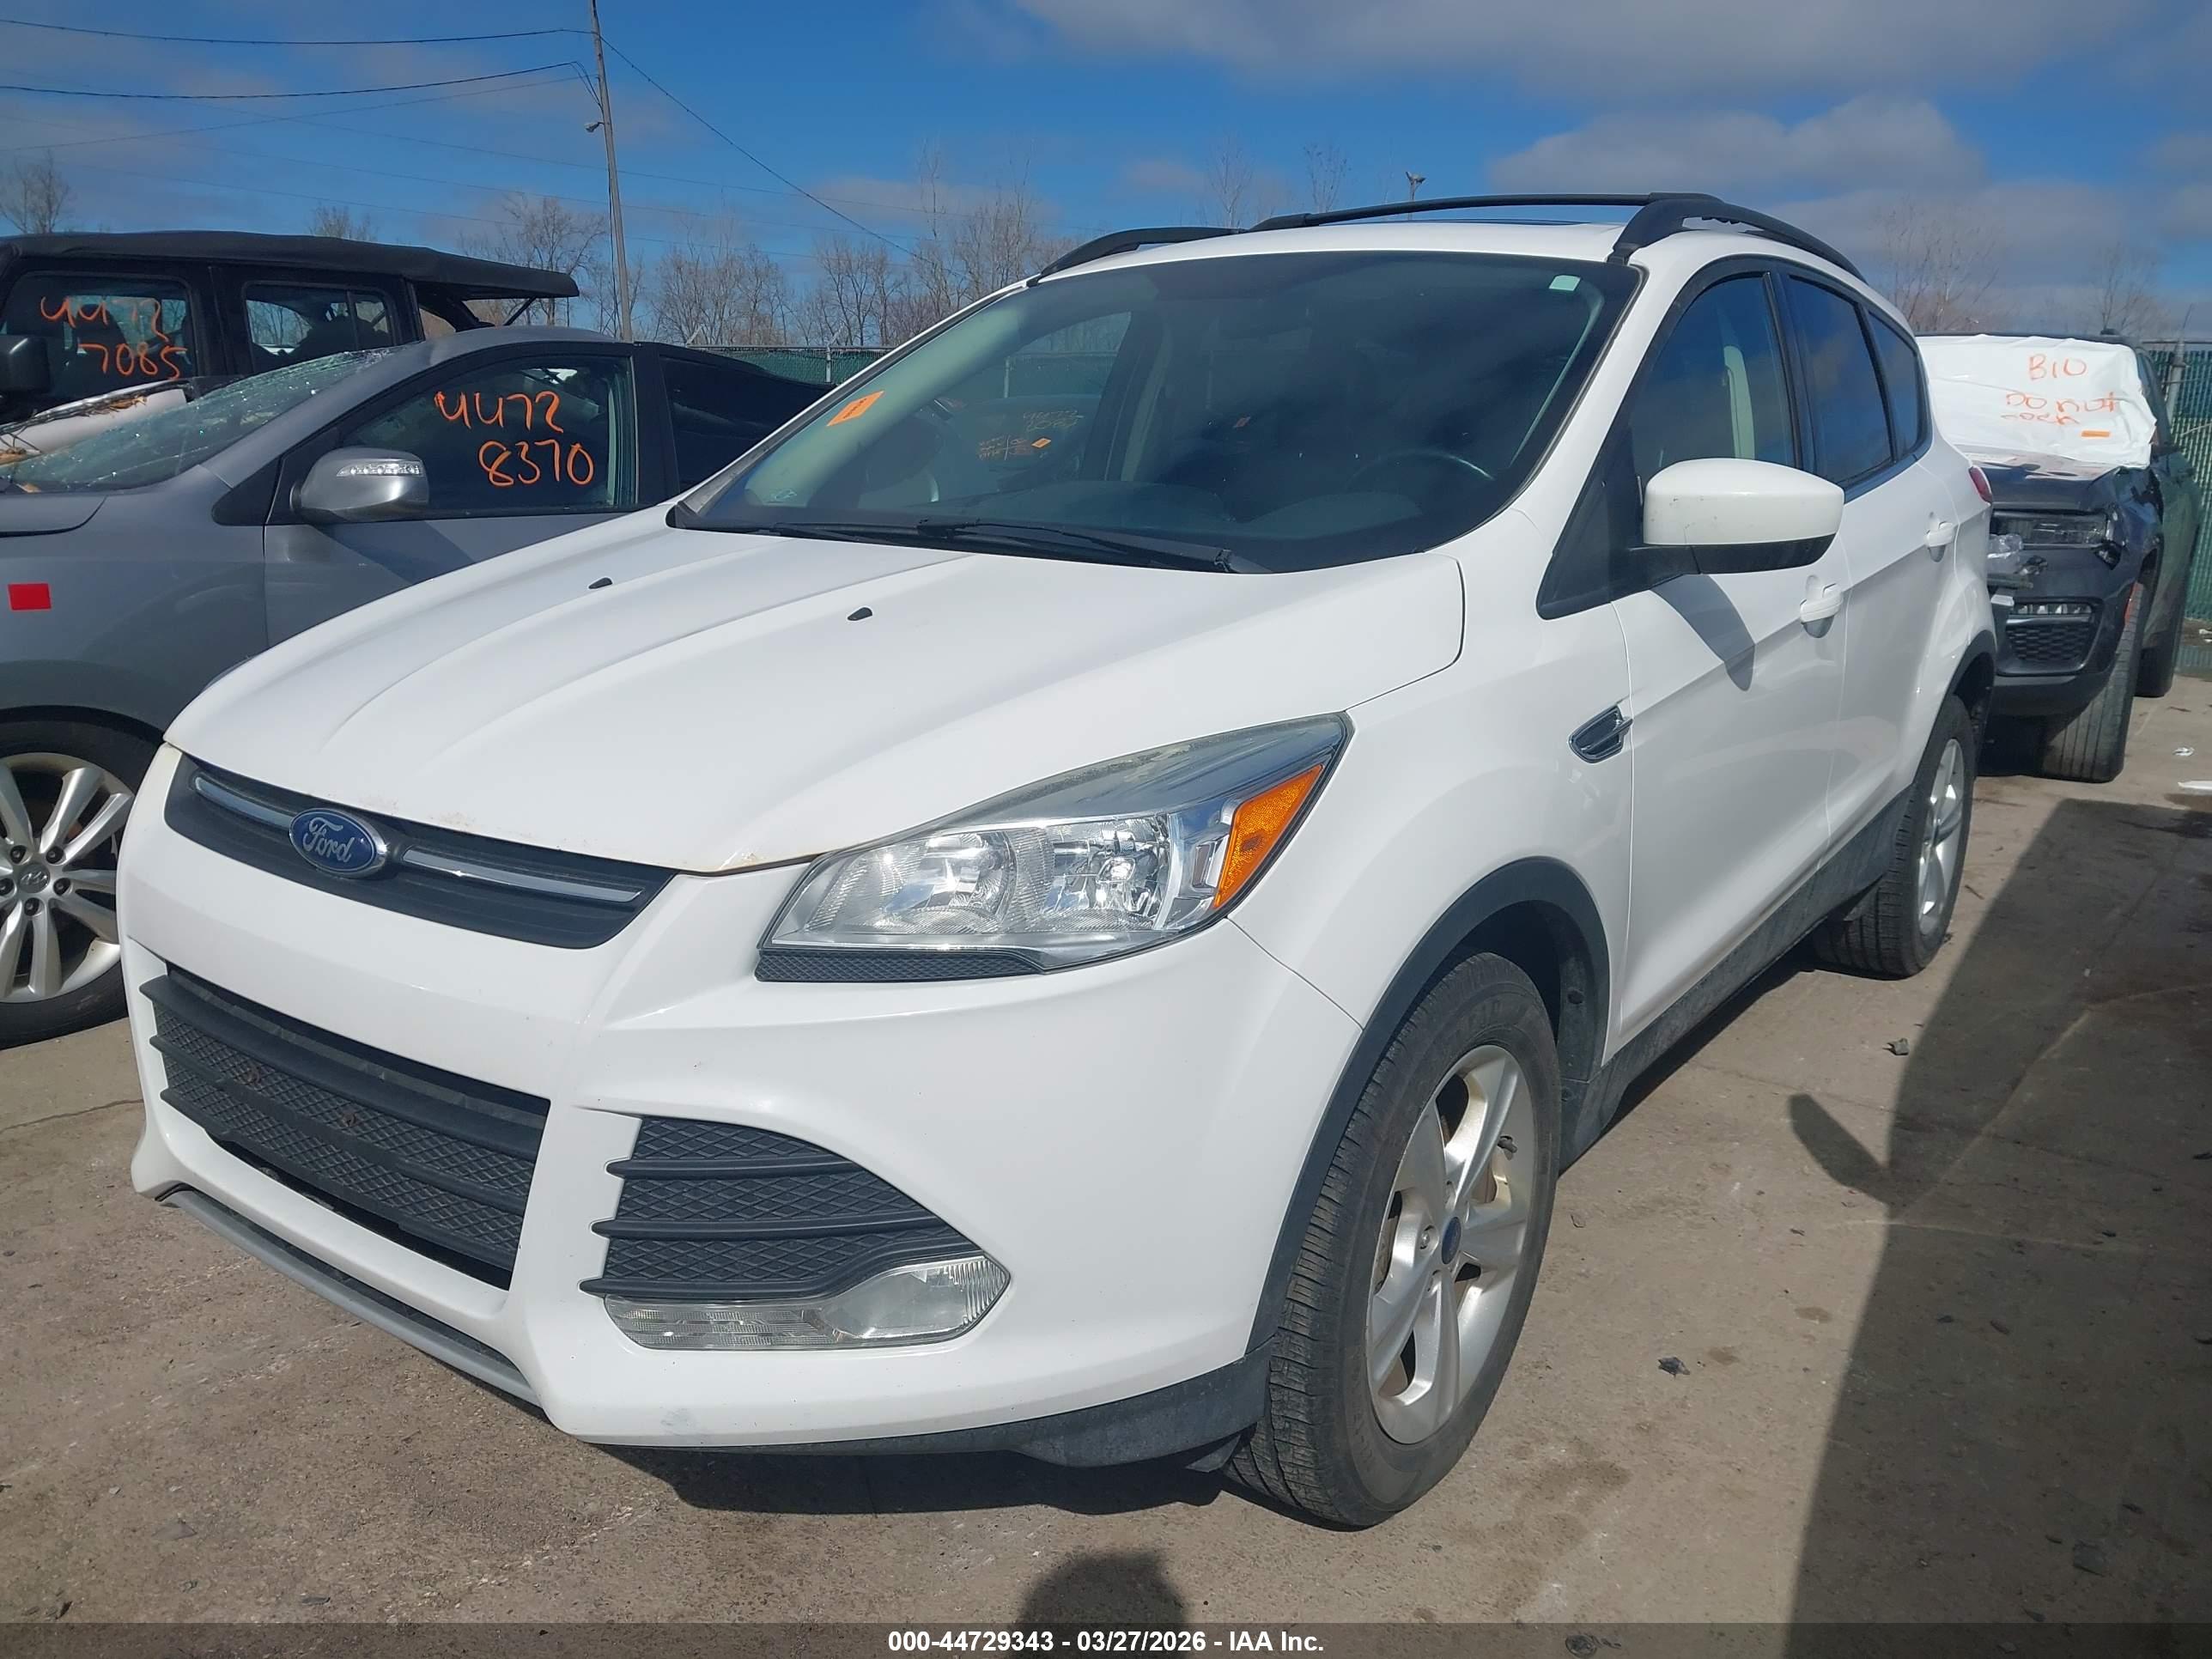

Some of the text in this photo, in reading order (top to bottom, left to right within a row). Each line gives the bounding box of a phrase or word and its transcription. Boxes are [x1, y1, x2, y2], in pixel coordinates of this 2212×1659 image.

[40, 295, 170, 343] 4472
[77, 341, 187, 380] 7085
[434, 391, 564, 434] 4472
[478, 439, 594, 487] 8370
[302, 817, 356, 862] Ford
